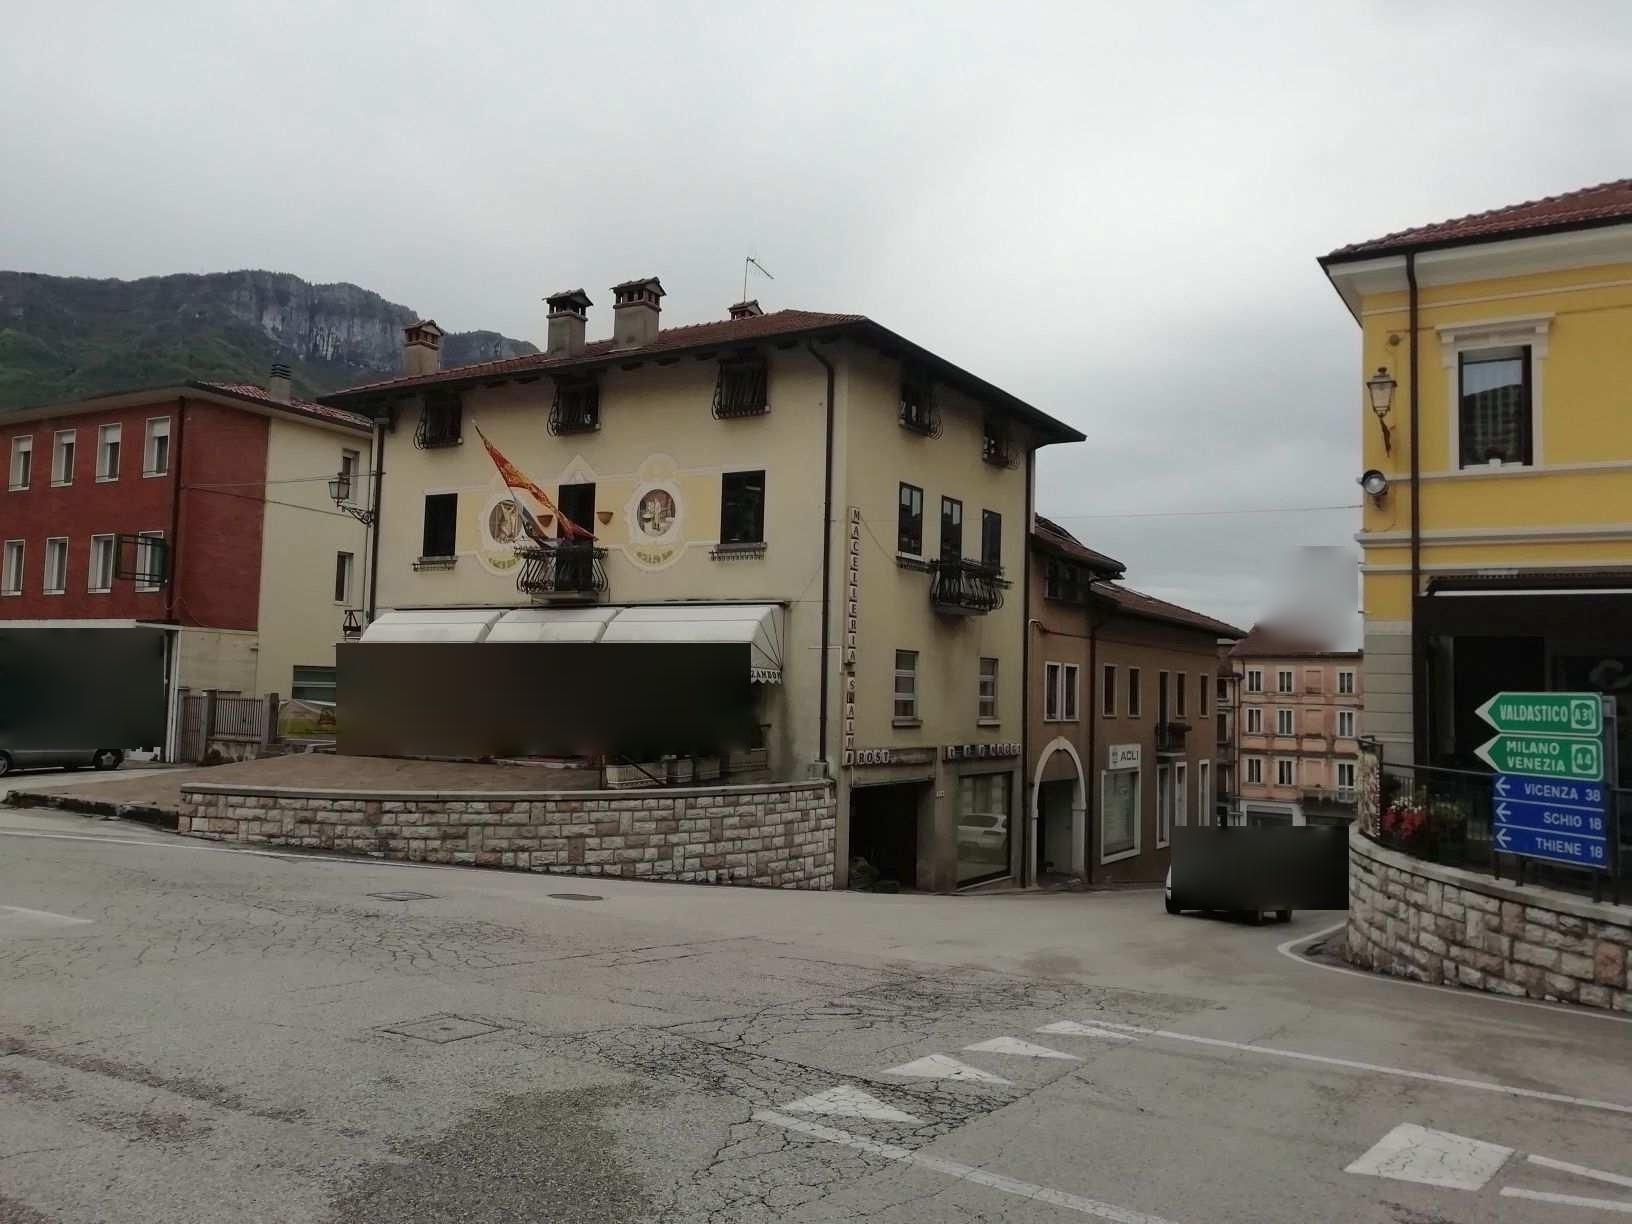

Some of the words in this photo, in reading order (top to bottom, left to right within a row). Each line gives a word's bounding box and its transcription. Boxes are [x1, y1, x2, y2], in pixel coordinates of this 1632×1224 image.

[1500, 705, 1568, 722] VALDASTICO
[1120, 750, 1139, 761] ACLI
[1507, 741, 1559, 755] MILANO
[1507, 757, 1566, 772] VENEZIA
[1577, 753, 1592, 765] A4
[1525, 783, 1578, 800] VICENZA
[1585, 789, 1600, 802] 38
[1544, 812, 1582, 827] SCHIO
[1590, 818, 1602, 830] 18
[1536, 837, 1582, 855] THIENE
[1590, 846, 1603, 858] 18
